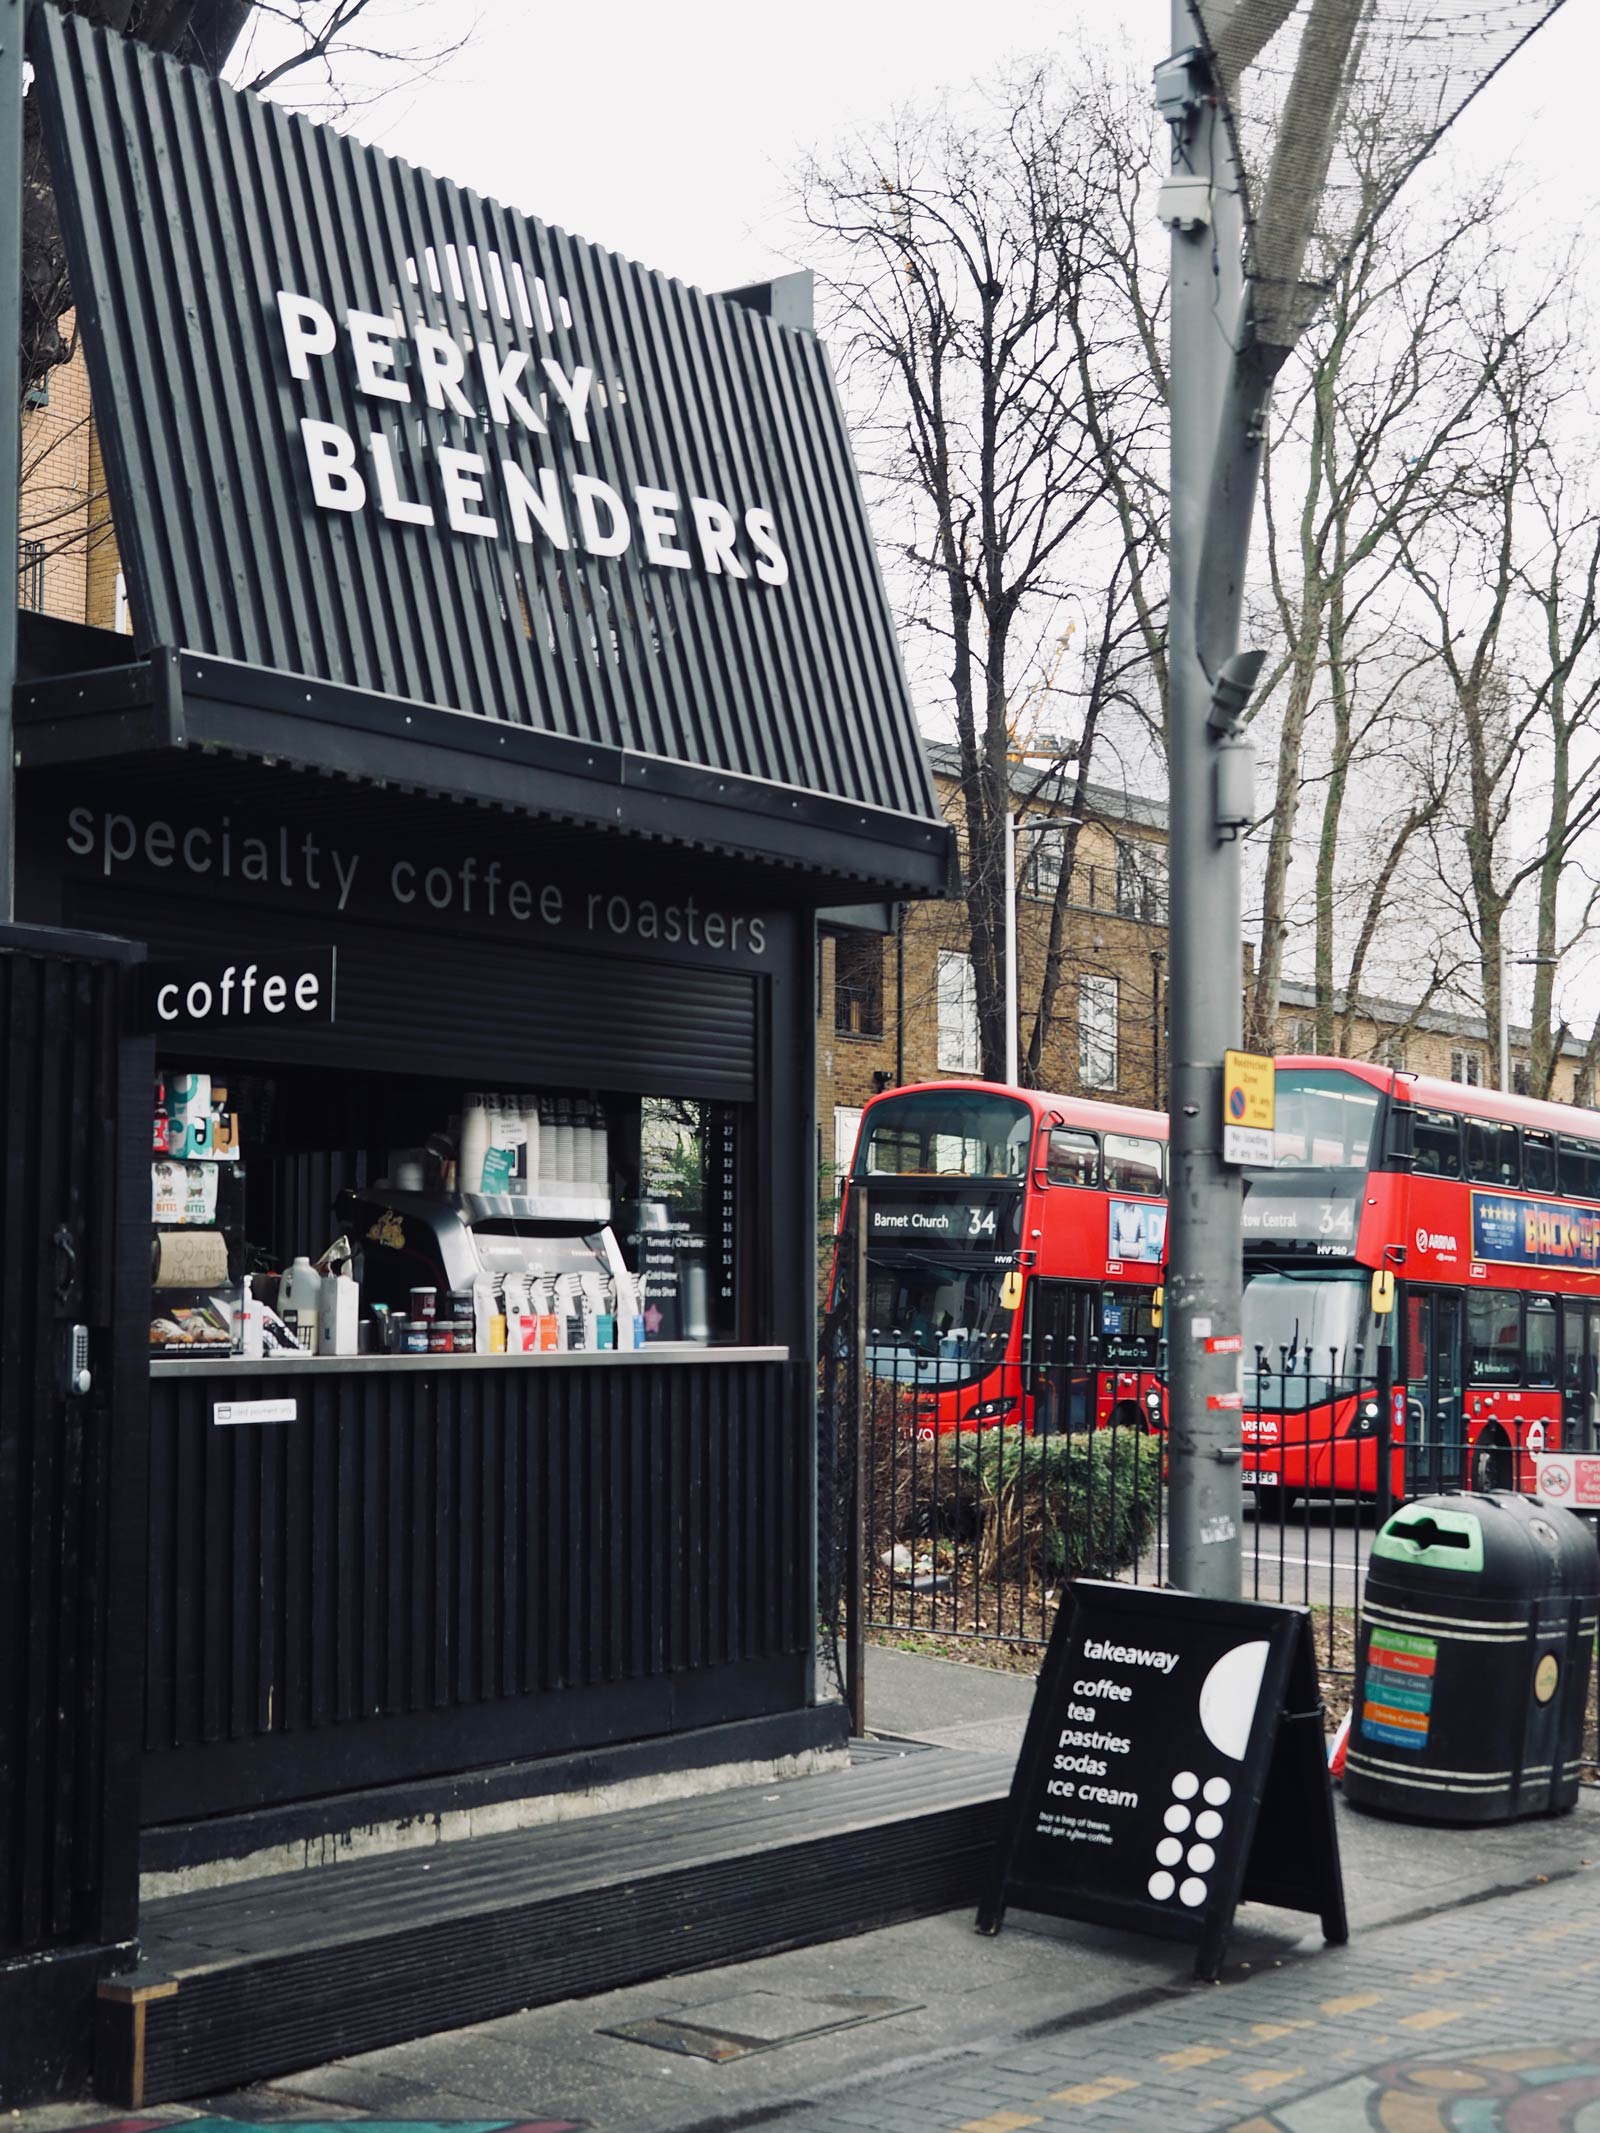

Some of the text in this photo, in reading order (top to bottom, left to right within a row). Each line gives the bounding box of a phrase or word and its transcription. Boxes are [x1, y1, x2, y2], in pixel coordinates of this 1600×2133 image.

[277, 290, 593, 444] PERKY
[300, 417, 790, 587] BLENDERS
[66, 805, 767, 955] specialty coffee roasters
[157, 964, 320, 1021] coffee
[874, 1208, 996, 1235] Barnet Church 34
[1262, 1211, 1297, 1228] Central
[1319, 1204, 1353, 1234] 34
[1524, 1208, 1575, 1258] BACK
[1428, 1234, 1457, 1251] ARRIVA
[1083, 1638, 1180, 1674] takeaway
[1072, 1678, 1133, 1703] coffee
[1067, 1702, 1096, 1723] tea
[1058, 1728, 1132, 1755] pastries
[1053, 1751, 1108, 1777] sodas
[1046, 1779, 1139, 1809] ice cream
